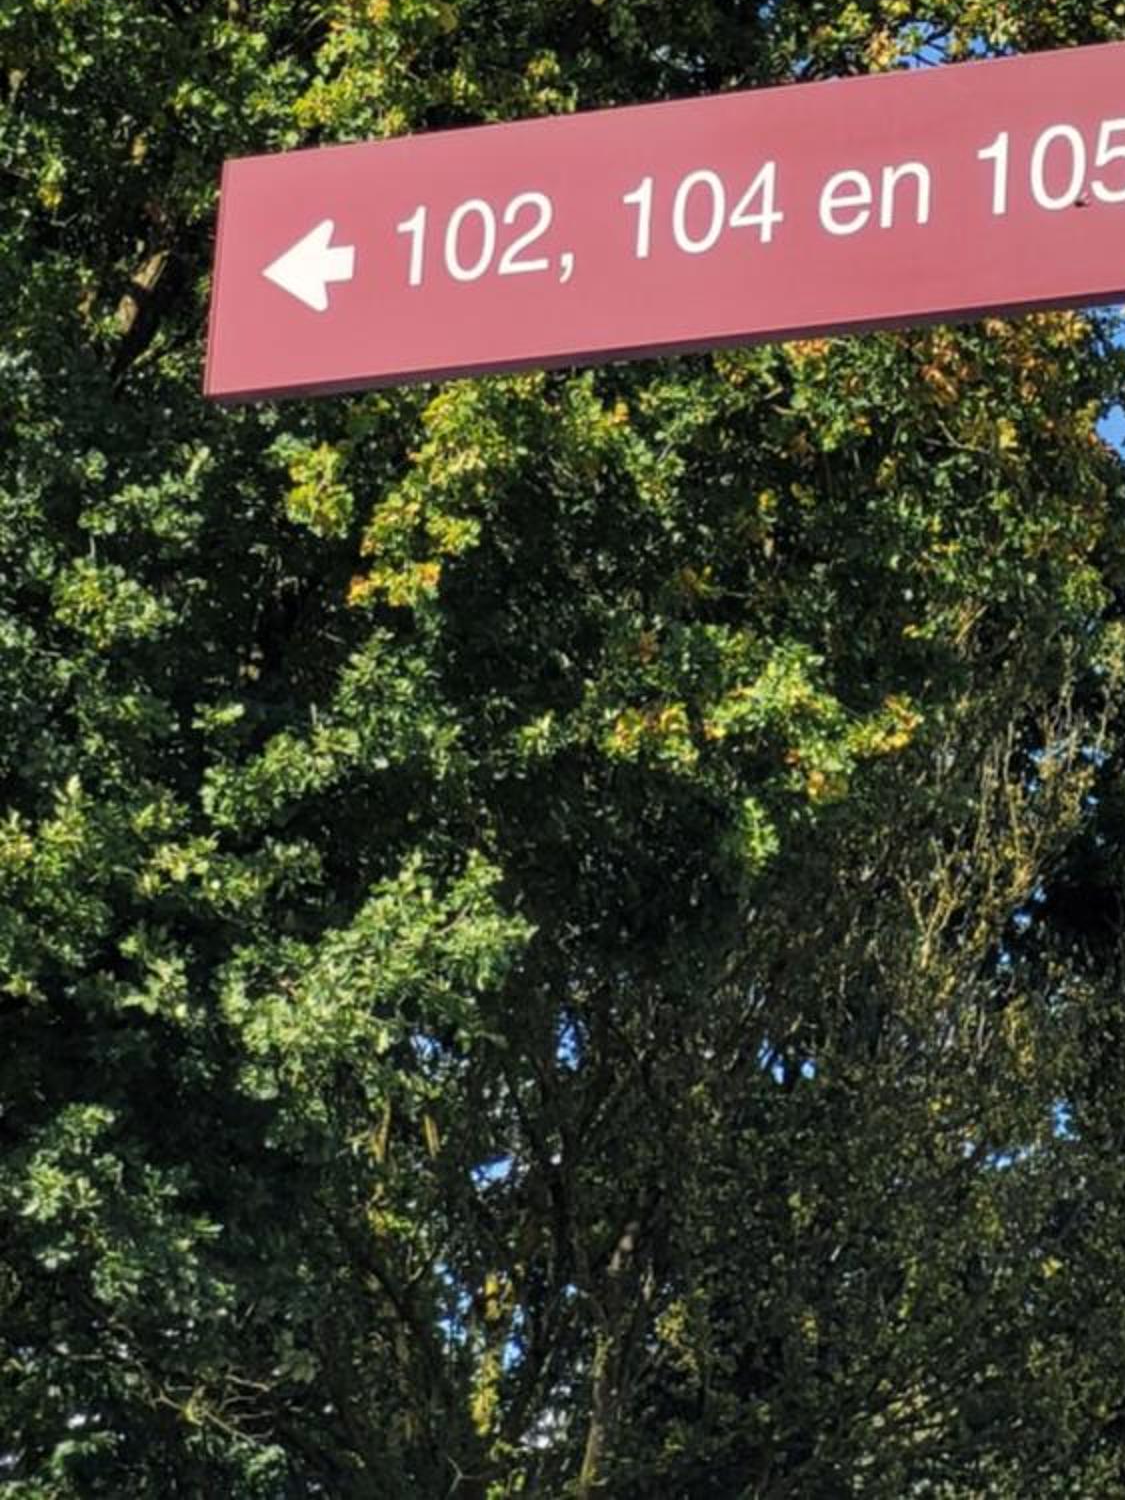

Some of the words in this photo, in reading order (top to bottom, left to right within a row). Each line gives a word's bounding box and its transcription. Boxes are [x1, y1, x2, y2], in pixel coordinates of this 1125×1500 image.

[396, 190, 575, 288] 102,
[621, 160, 785, 260] 104
[818, 161, 931, 236] en
